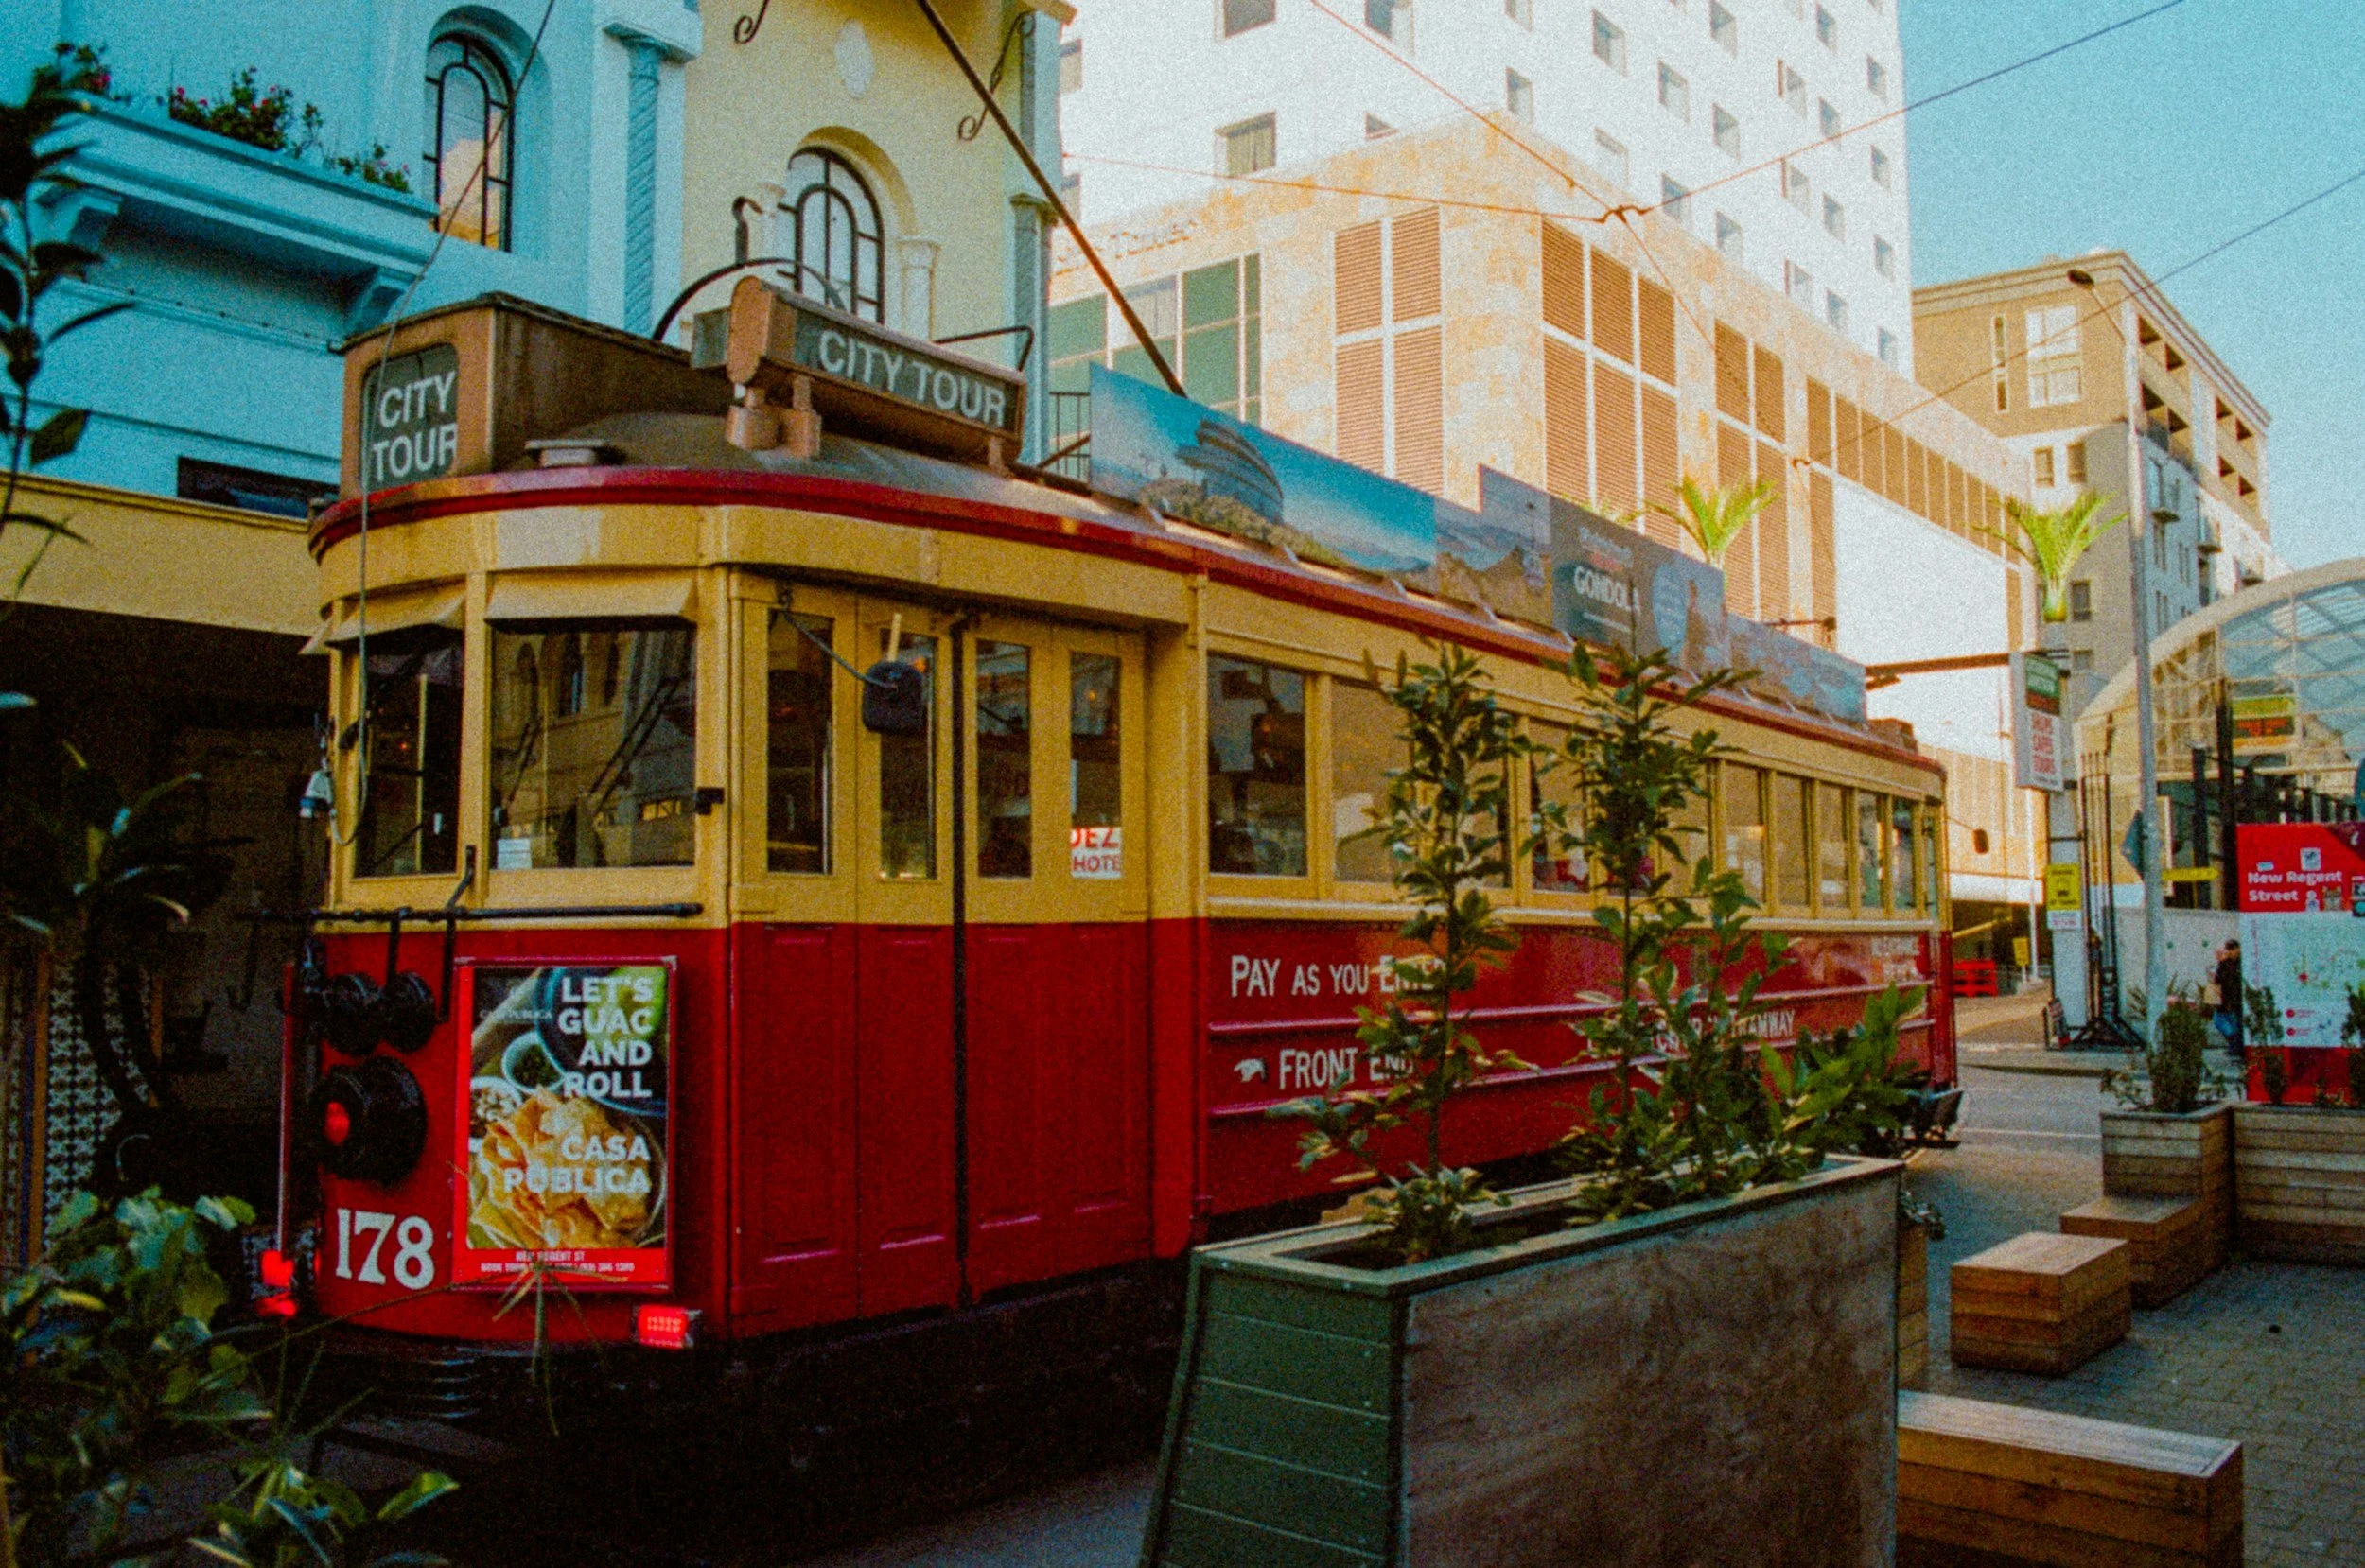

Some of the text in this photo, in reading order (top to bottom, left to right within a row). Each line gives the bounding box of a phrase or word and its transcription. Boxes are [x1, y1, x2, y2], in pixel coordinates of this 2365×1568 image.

[819, 330, 1007, 428] CITY TOUR
[379, 370, 457, 429] CITY
[372, 422, 458, 483] TOUR
[2248, 870, 2343, 887] New Regent
[2249, 889, 2300, 902] Street
[561, 974, 654, 1004] LET'S
[1231, 954, 1282, 998] PAY
[1291, 963, 1321, 997] AS
[1328, 963, 1370, 996] YOU
[558, 1006, 655, 1035] GUAC
[578, 1039, 653, 1067] AND
[1279, 1046, 1359, 1090] FRONT
[563, 1070, 653, 1098] ROLL
[561, 1134, 651, 1162] CASA
[335, 1207, 435, 1291] 178
